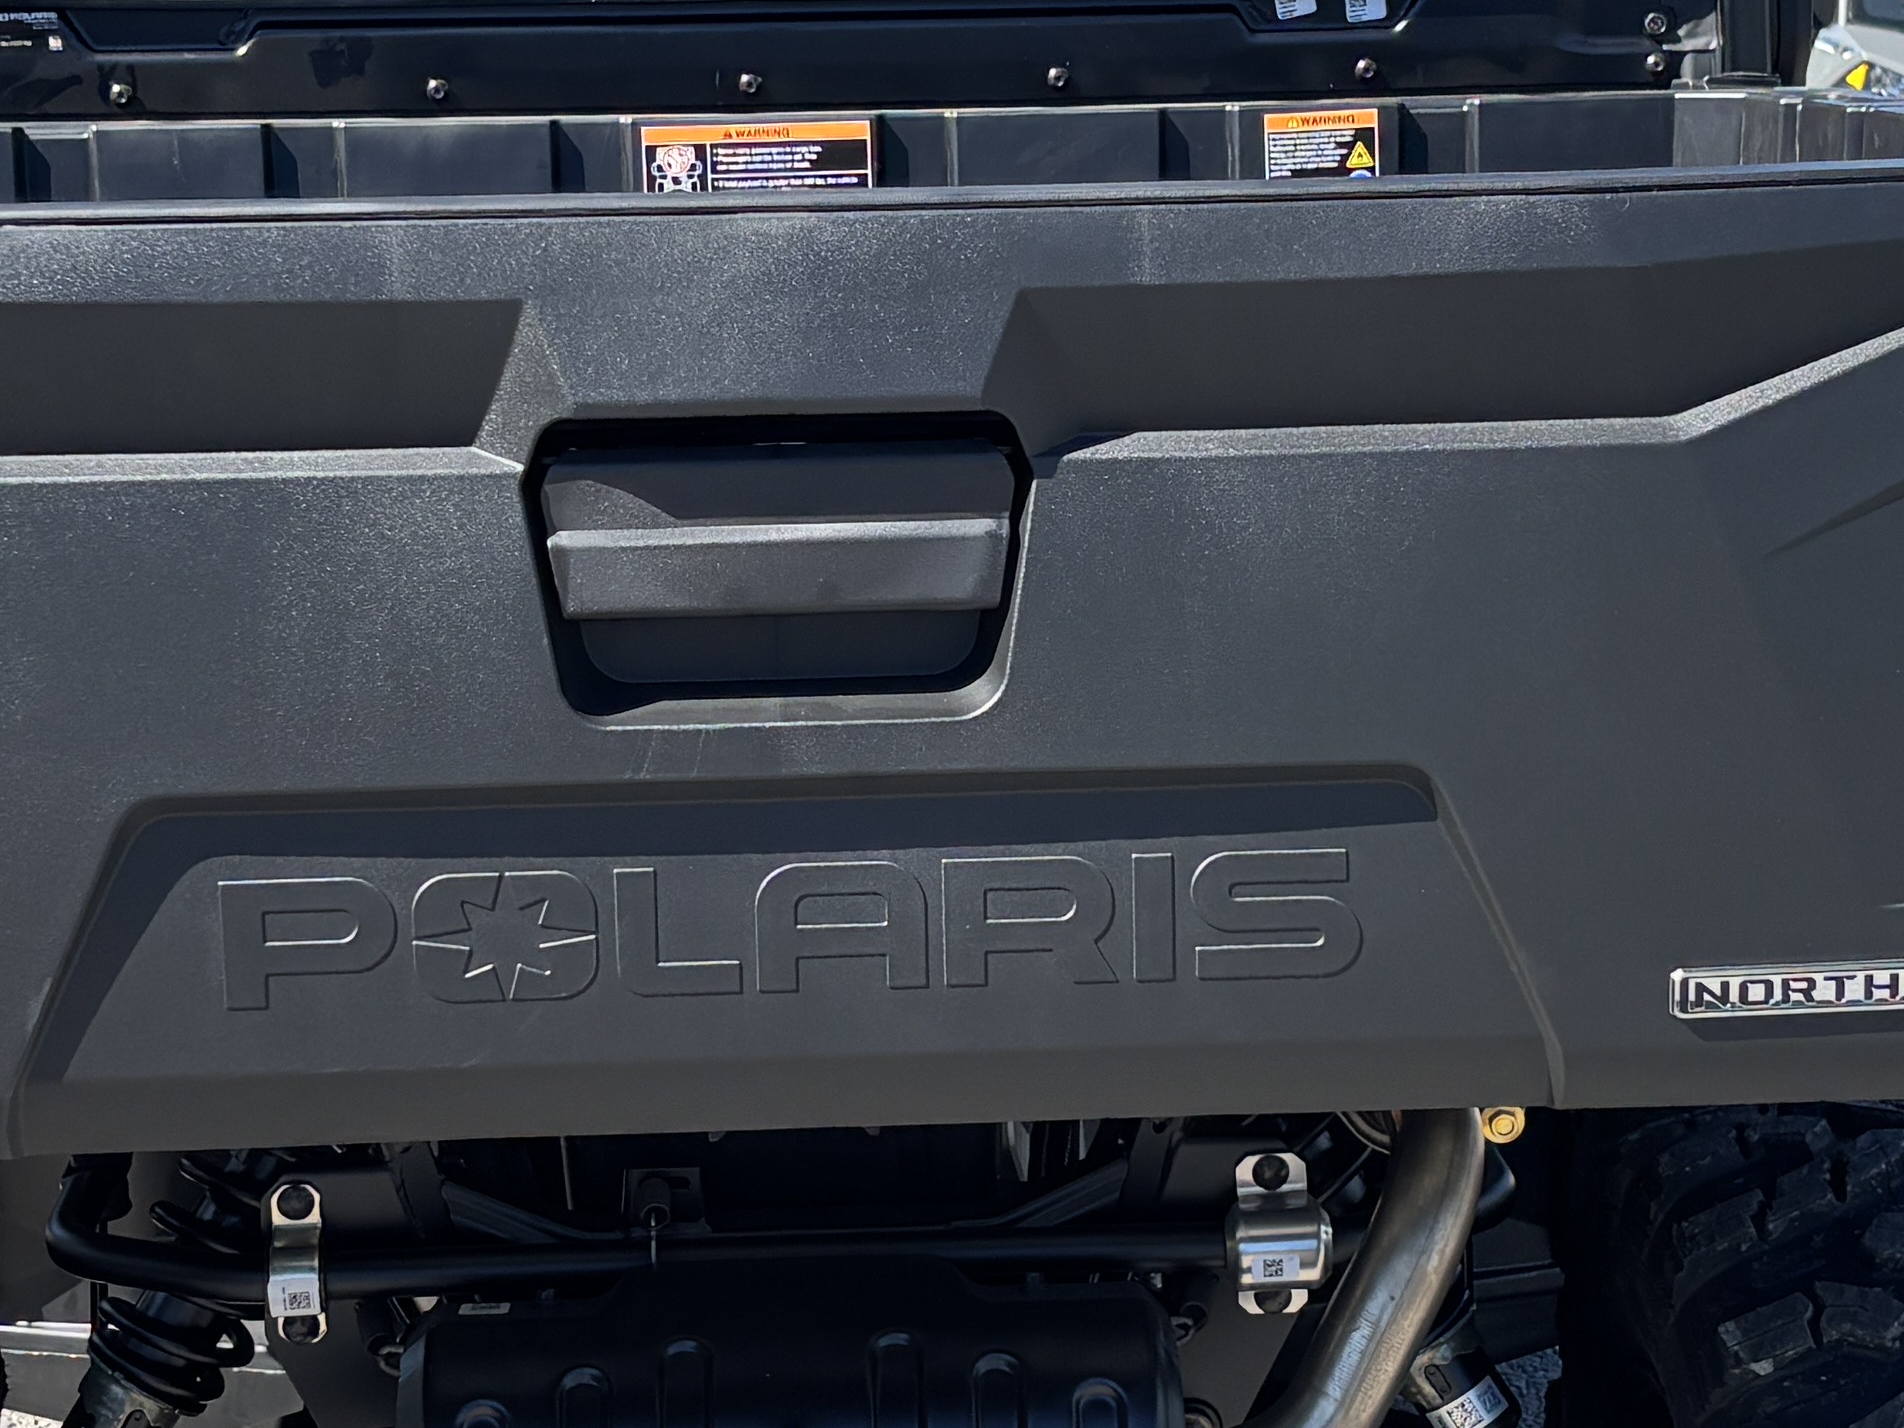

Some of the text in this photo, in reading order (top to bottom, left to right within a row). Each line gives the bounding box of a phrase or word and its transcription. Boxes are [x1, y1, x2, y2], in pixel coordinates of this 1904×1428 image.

[1300, 114, 1355, 127] WARNING
[735, 126, 791, 139] WARNING
[216, 847, 1365, 1011] POLARIS
